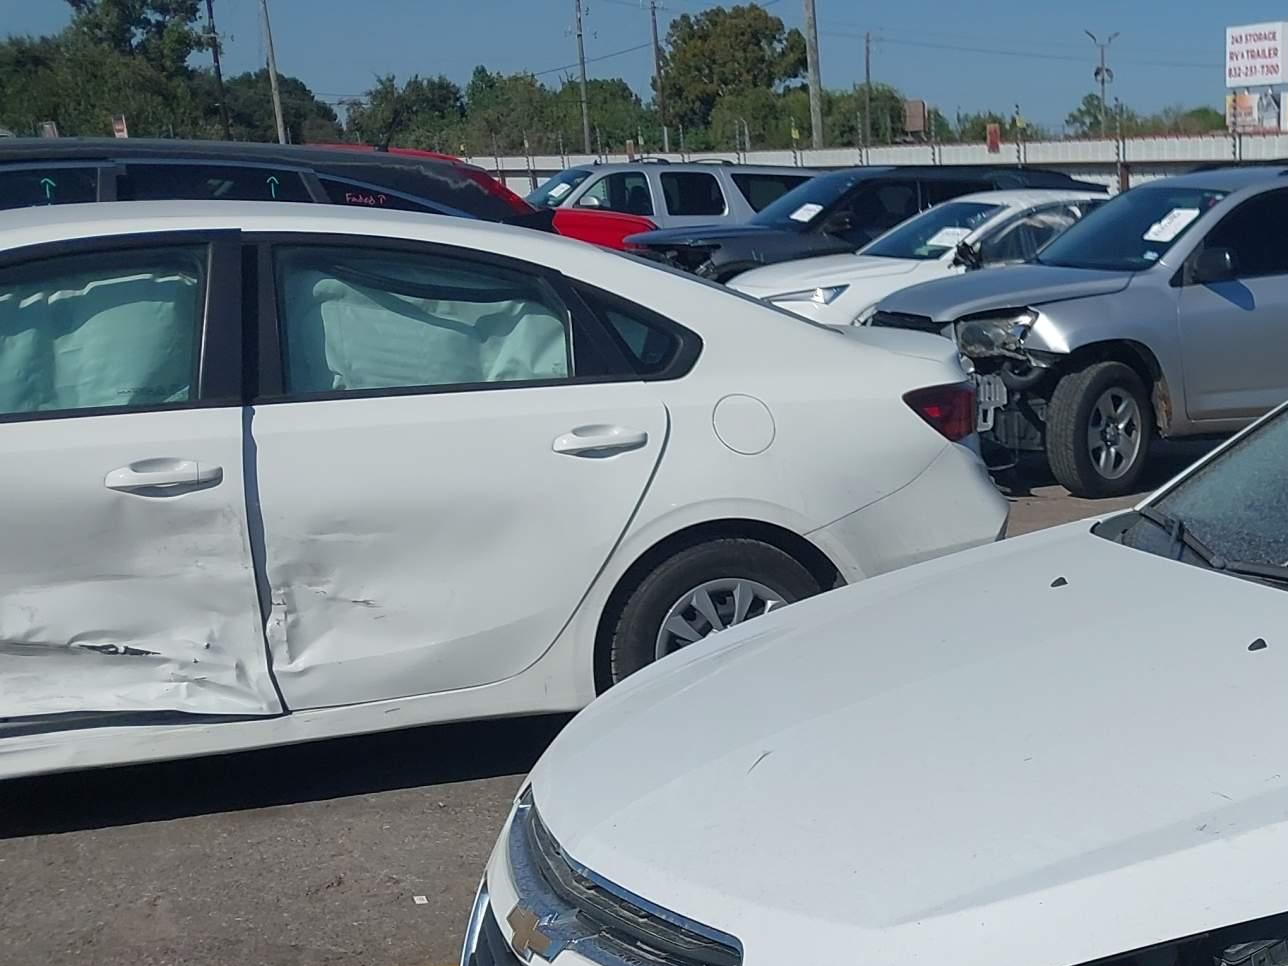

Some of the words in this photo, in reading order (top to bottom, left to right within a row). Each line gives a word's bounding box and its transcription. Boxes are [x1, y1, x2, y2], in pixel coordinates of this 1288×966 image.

[1245, 31, 1277, 44] STORAGE
[1229, 50, 1240, 61] RV
[1246, 47, 1279, 60] TRAILER
